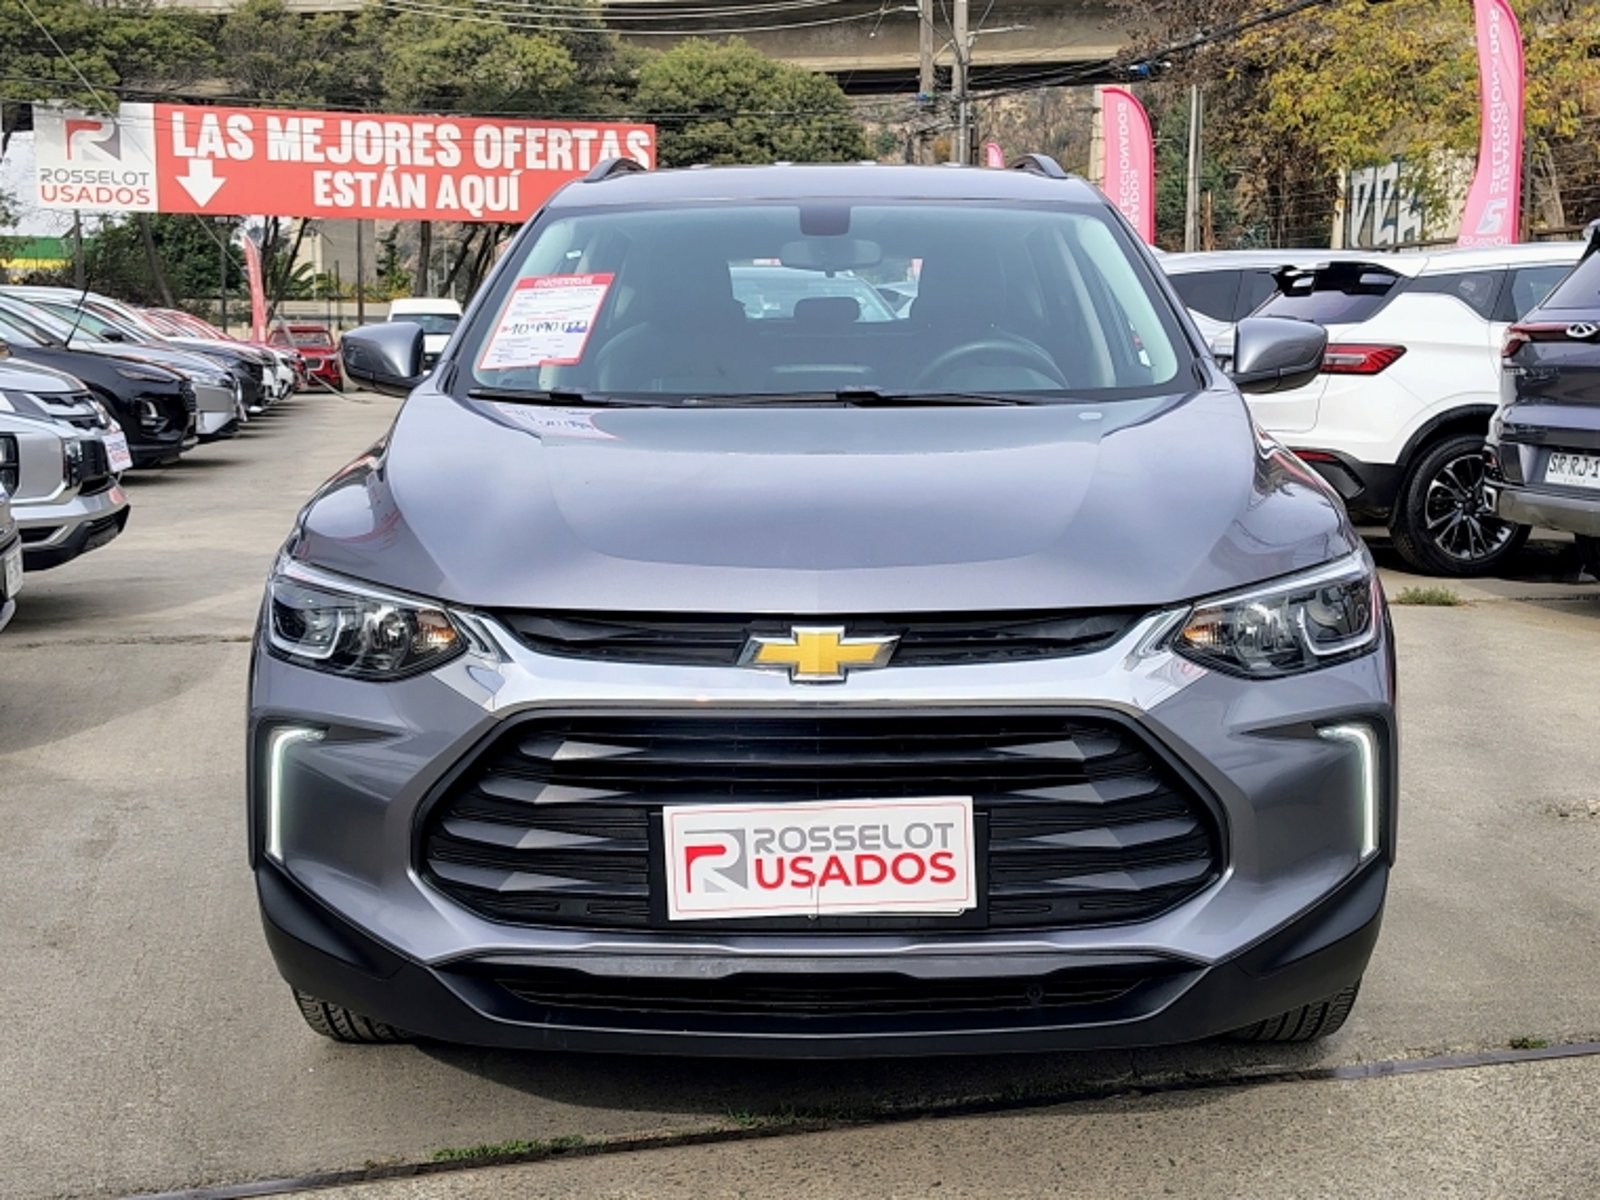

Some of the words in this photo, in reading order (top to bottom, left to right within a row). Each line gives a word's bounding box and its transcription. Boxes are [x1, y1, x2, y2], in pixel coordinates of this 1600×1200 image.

[171, 111, 254, 160] LAS
[266, 116, 462, 169] MEJORES
[473, 124, 651, 171] OFERTAS
[40, 168, 150, 186] ROSSELOT
[313, 166, 426, 209] ESTÁN
[436, 170, 523, 217] AQUÍ
[40, 185, 151, 205] USADOS
[753, 822, 954, 854] ROSSELOT
[755, 851, 956, 889] USADOS
